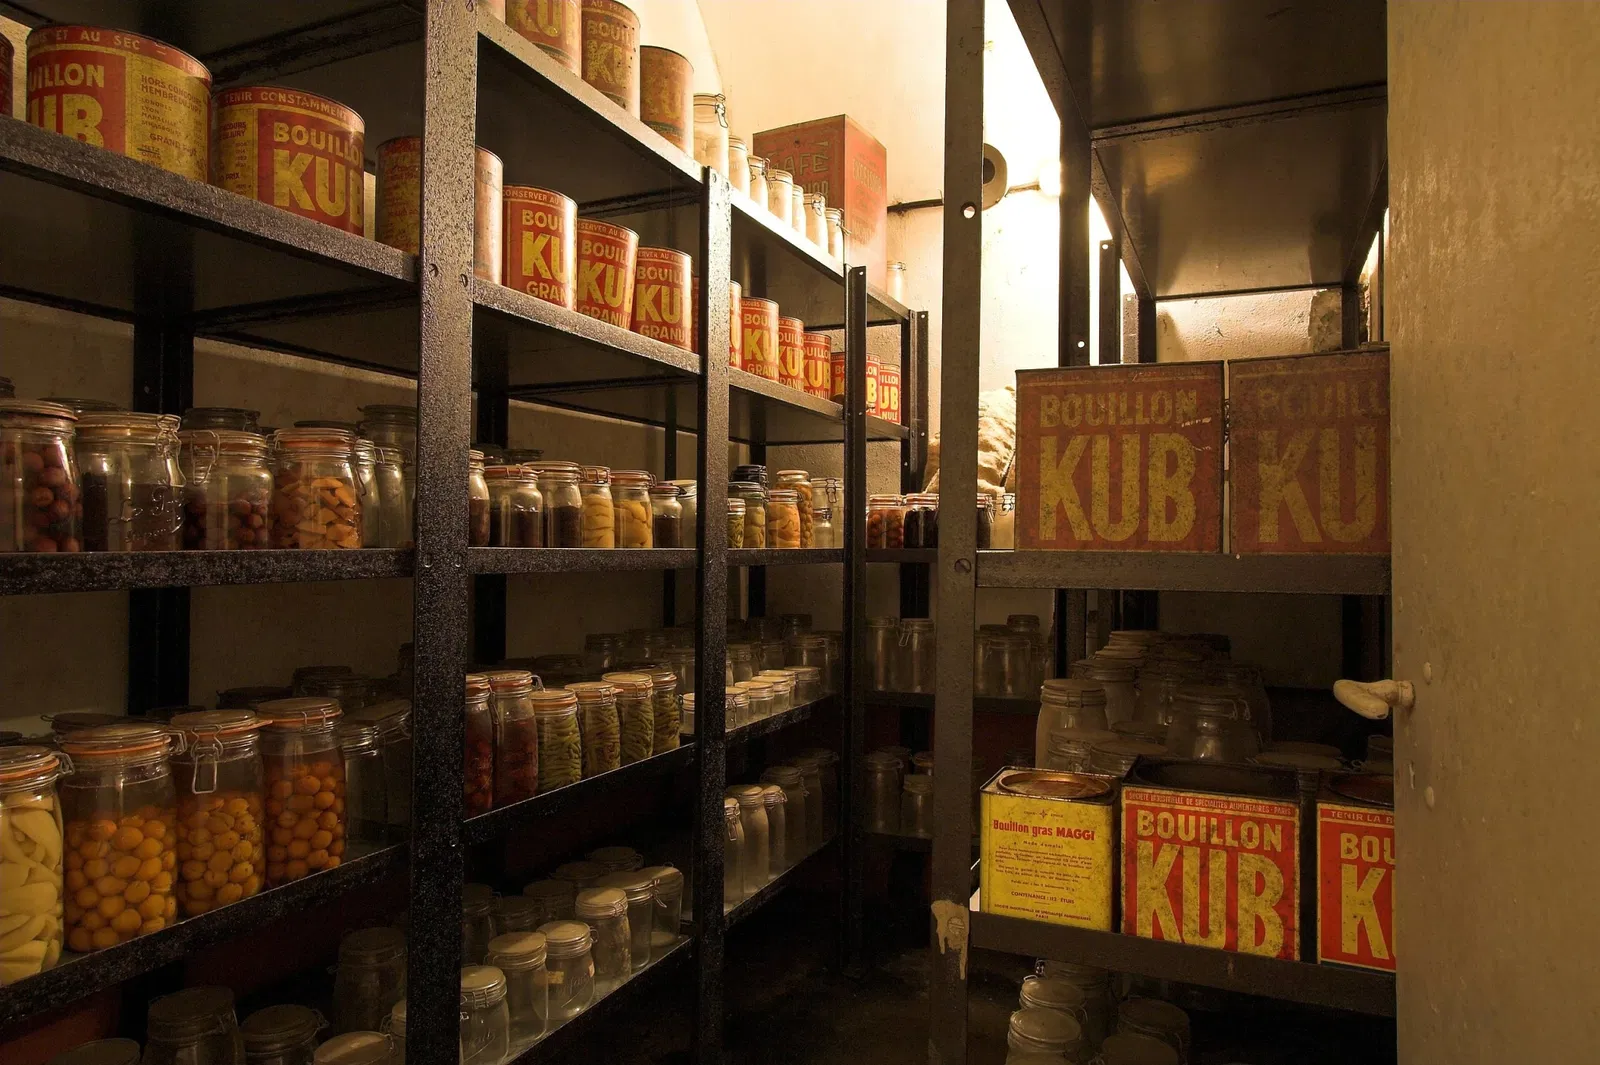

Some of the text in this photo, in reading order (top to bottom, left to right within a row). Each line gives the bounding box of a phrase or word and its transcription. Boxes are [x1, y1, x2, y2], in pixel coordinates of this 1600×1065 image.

[80, 31, 101, 43] AU
[113, 35, 141, 51] SEC
[141, 74, 167, 89] HORS
[141, 84, 177, 103] MEMBRE
[1040, 388, 1198, 428] BOUILLON
[1038, 432, 1197, 543] KUB
[993, 819, 1095, 841] Bouillon gras MAGGI
[1136, 809, 1282, 852] BOUILLON
[1331, 810, 1395, 825] TENIR LA B
[1136, 839, 1285, 959] KUB
[1341, 863, 1396, 960] K
